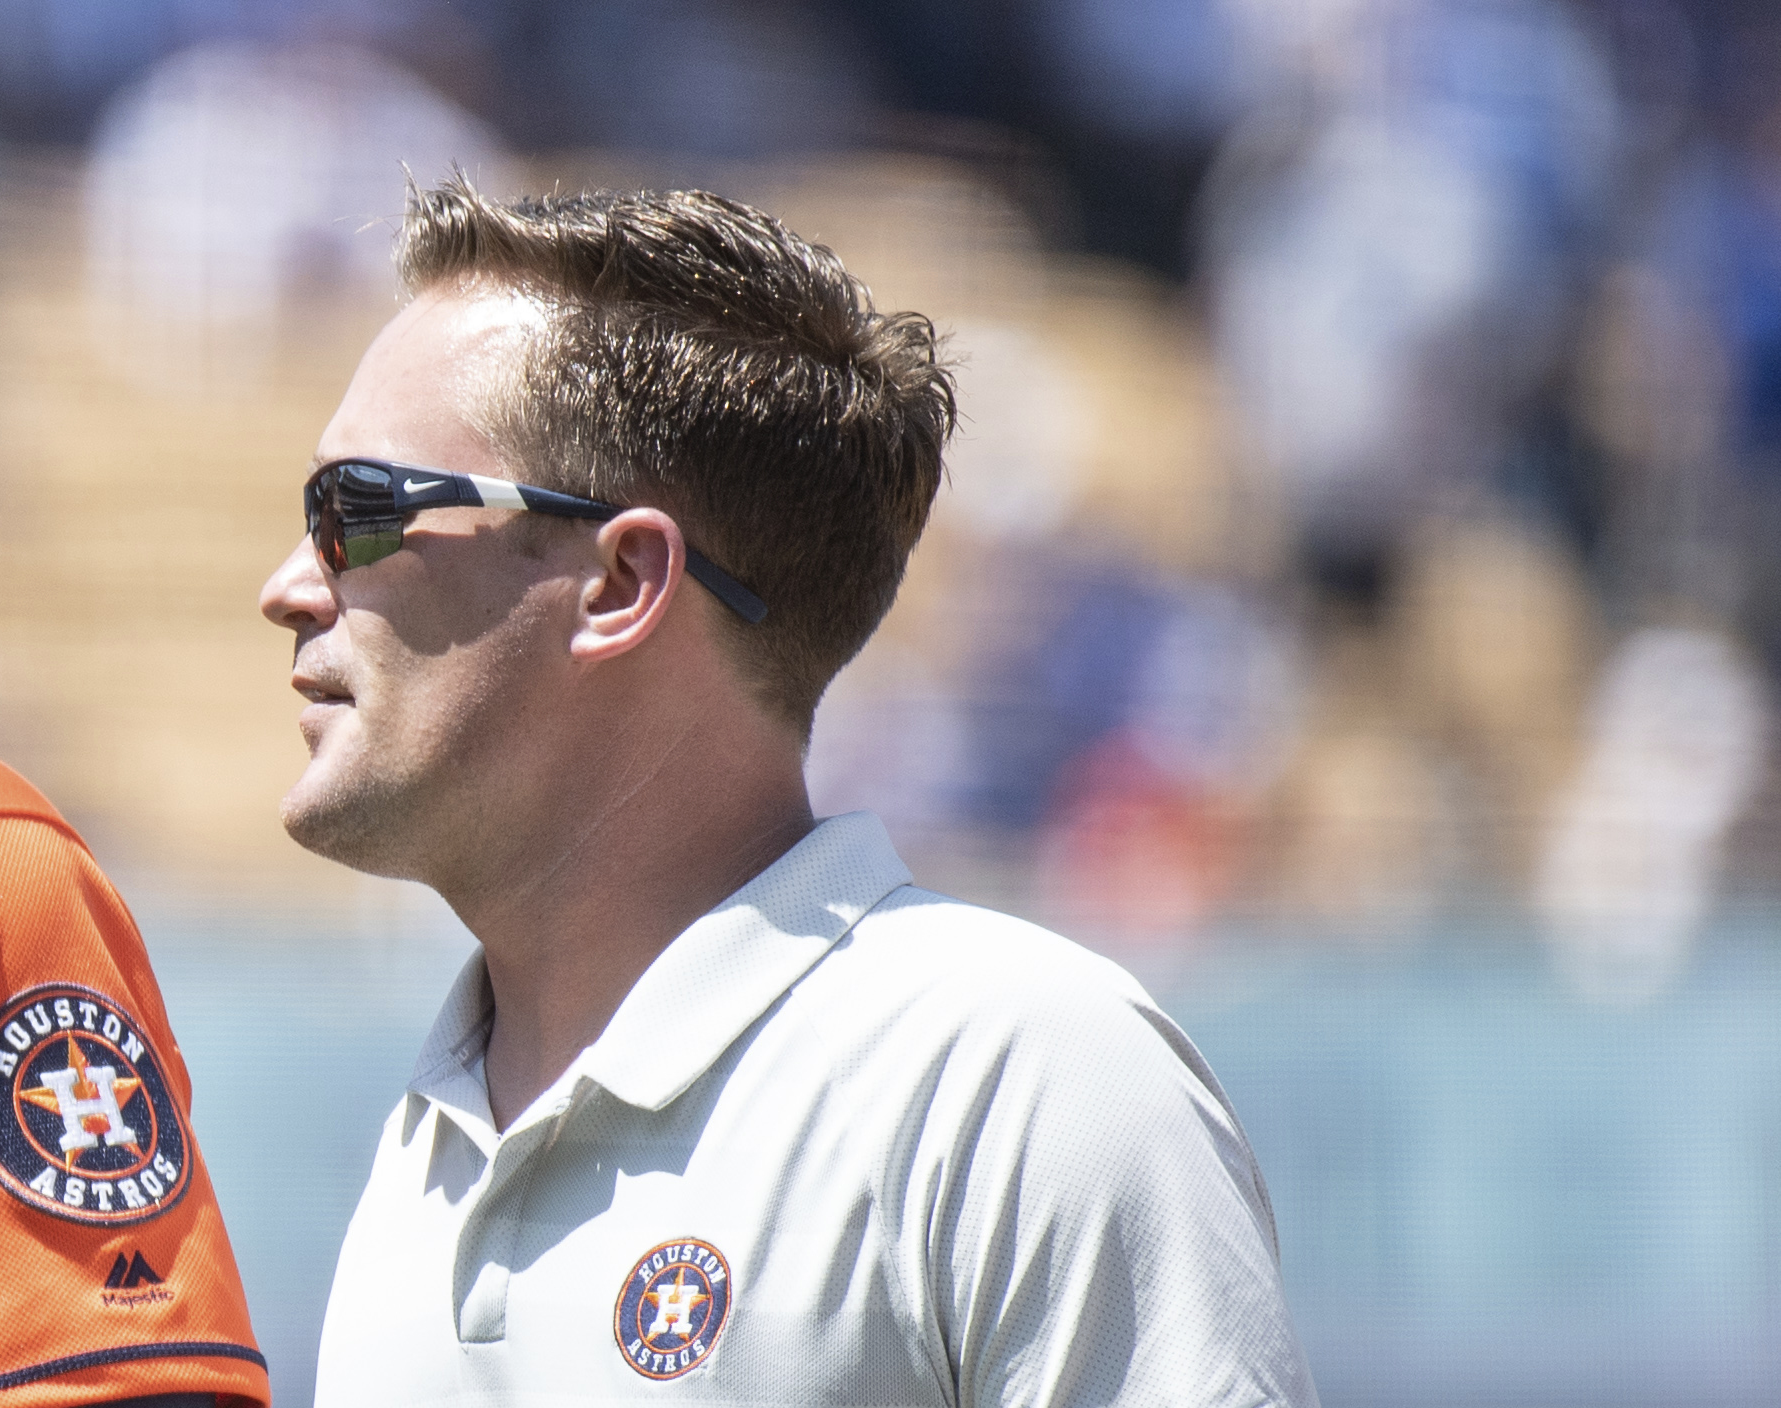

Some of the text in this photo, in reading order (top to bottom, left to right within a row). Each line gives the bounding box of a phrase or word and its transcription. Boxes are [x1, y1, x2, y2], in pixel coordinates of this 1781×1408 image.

[39, 1066, 137, 1152] H
[30, 1153, 178, 1212] ASTROS
[638, 1244, 726, 1284] HOUSTON
[102, 1287, 175, 1310] Majestic
[648, 1284, 700, 1334] H
[627, 1338, 705, 1372] ASTROS
